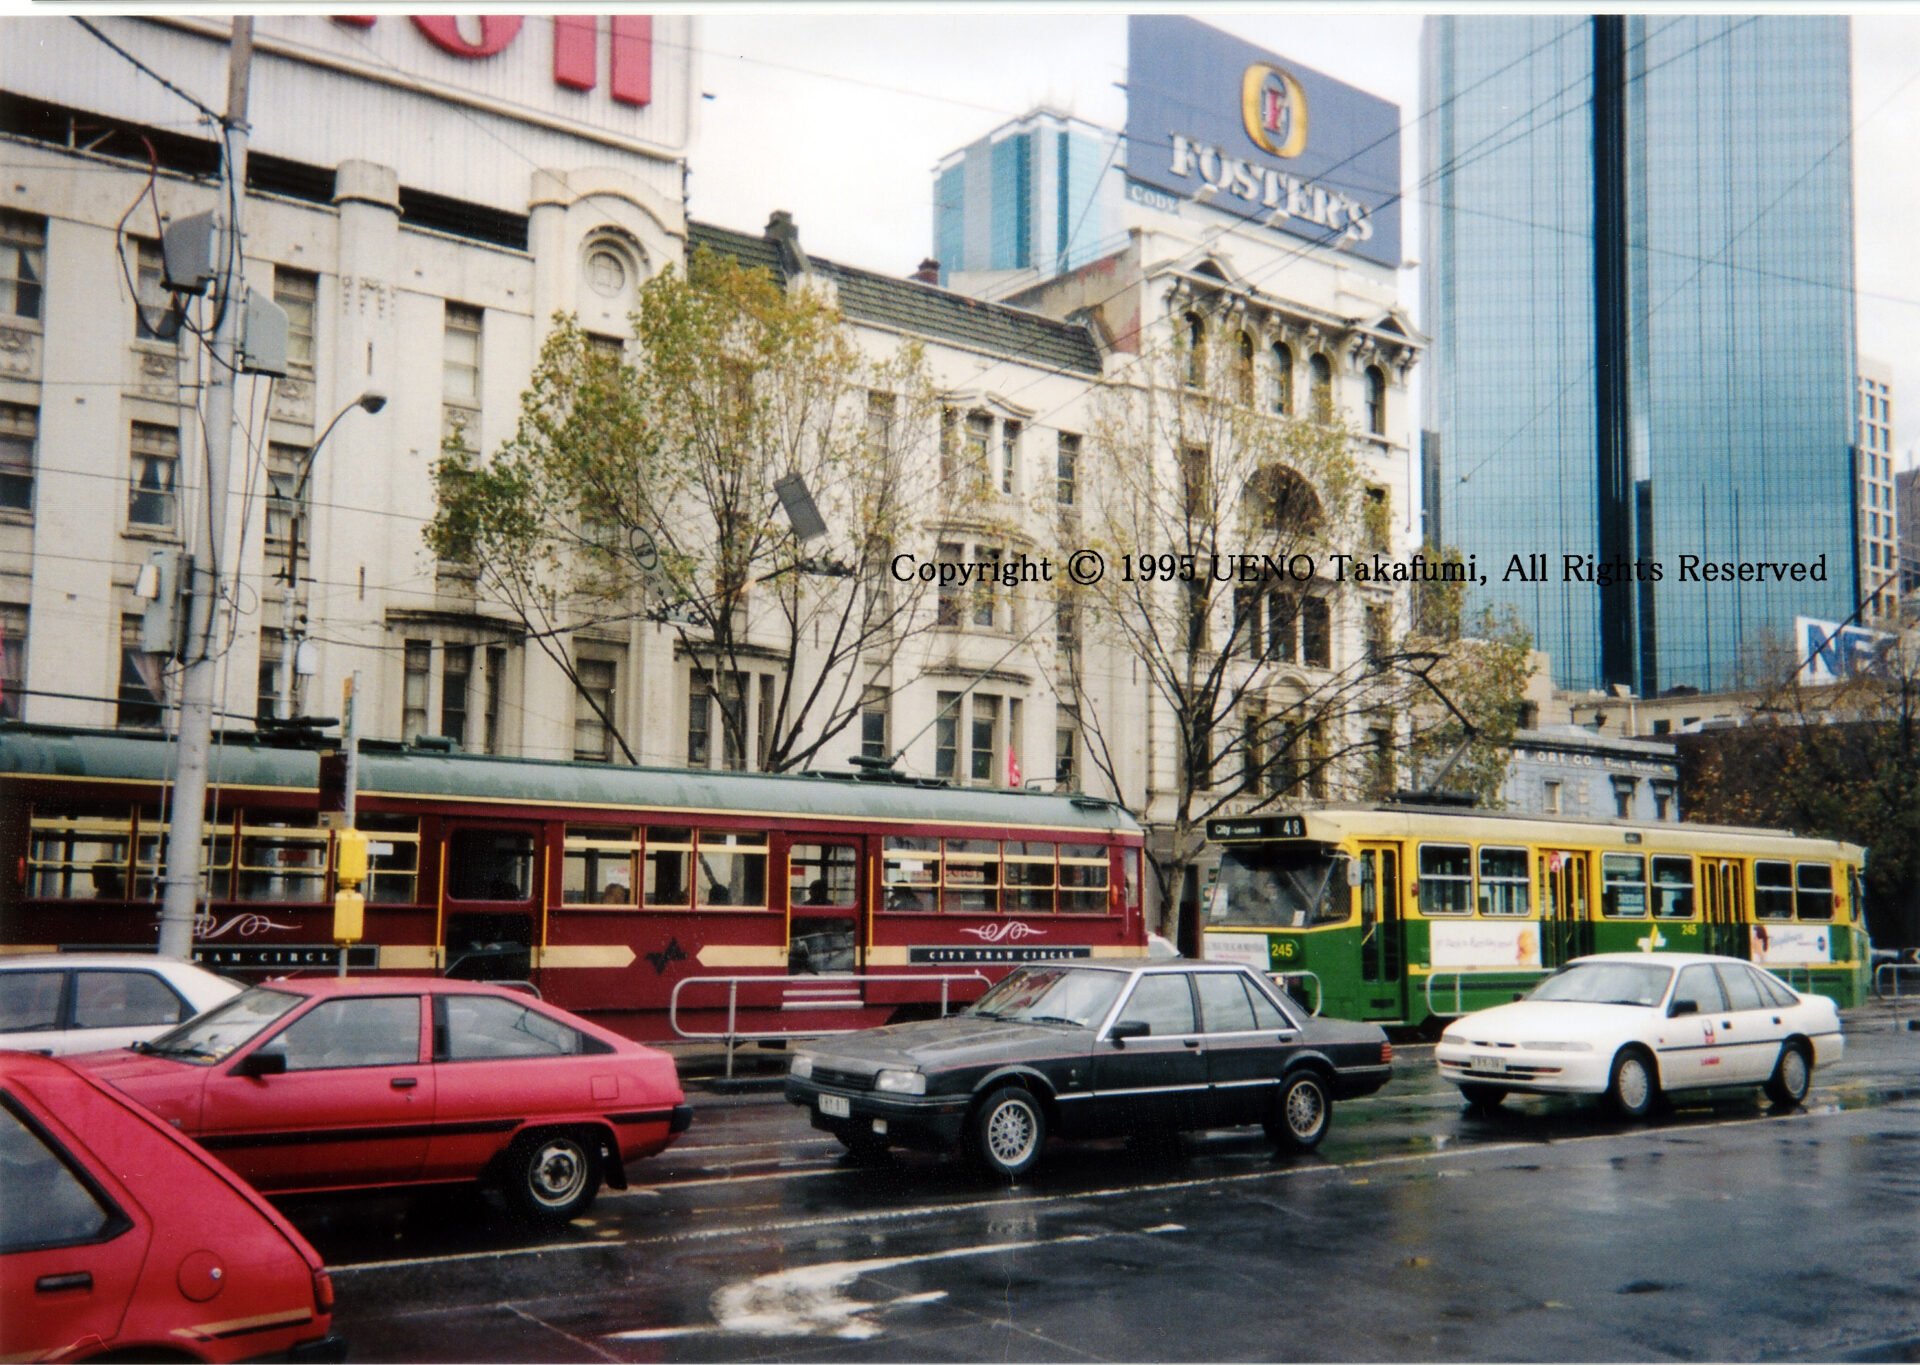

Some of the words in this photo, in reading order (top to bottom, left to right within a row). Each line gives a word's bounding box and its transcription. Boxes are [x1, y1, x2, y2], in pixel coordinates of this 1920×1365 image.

[1168, 131, 1374, 242] FOSTER'S
[1283, 820, 1301, 835] 48
[259, 952, 347, 962] CIRCL
[928, 951, 965, 960] CITY
[976, 951, 1014, 960] TRAM
[1022, 951, 1076, 960] CIRCLE
[1271, 943, 1294, 958] 245
